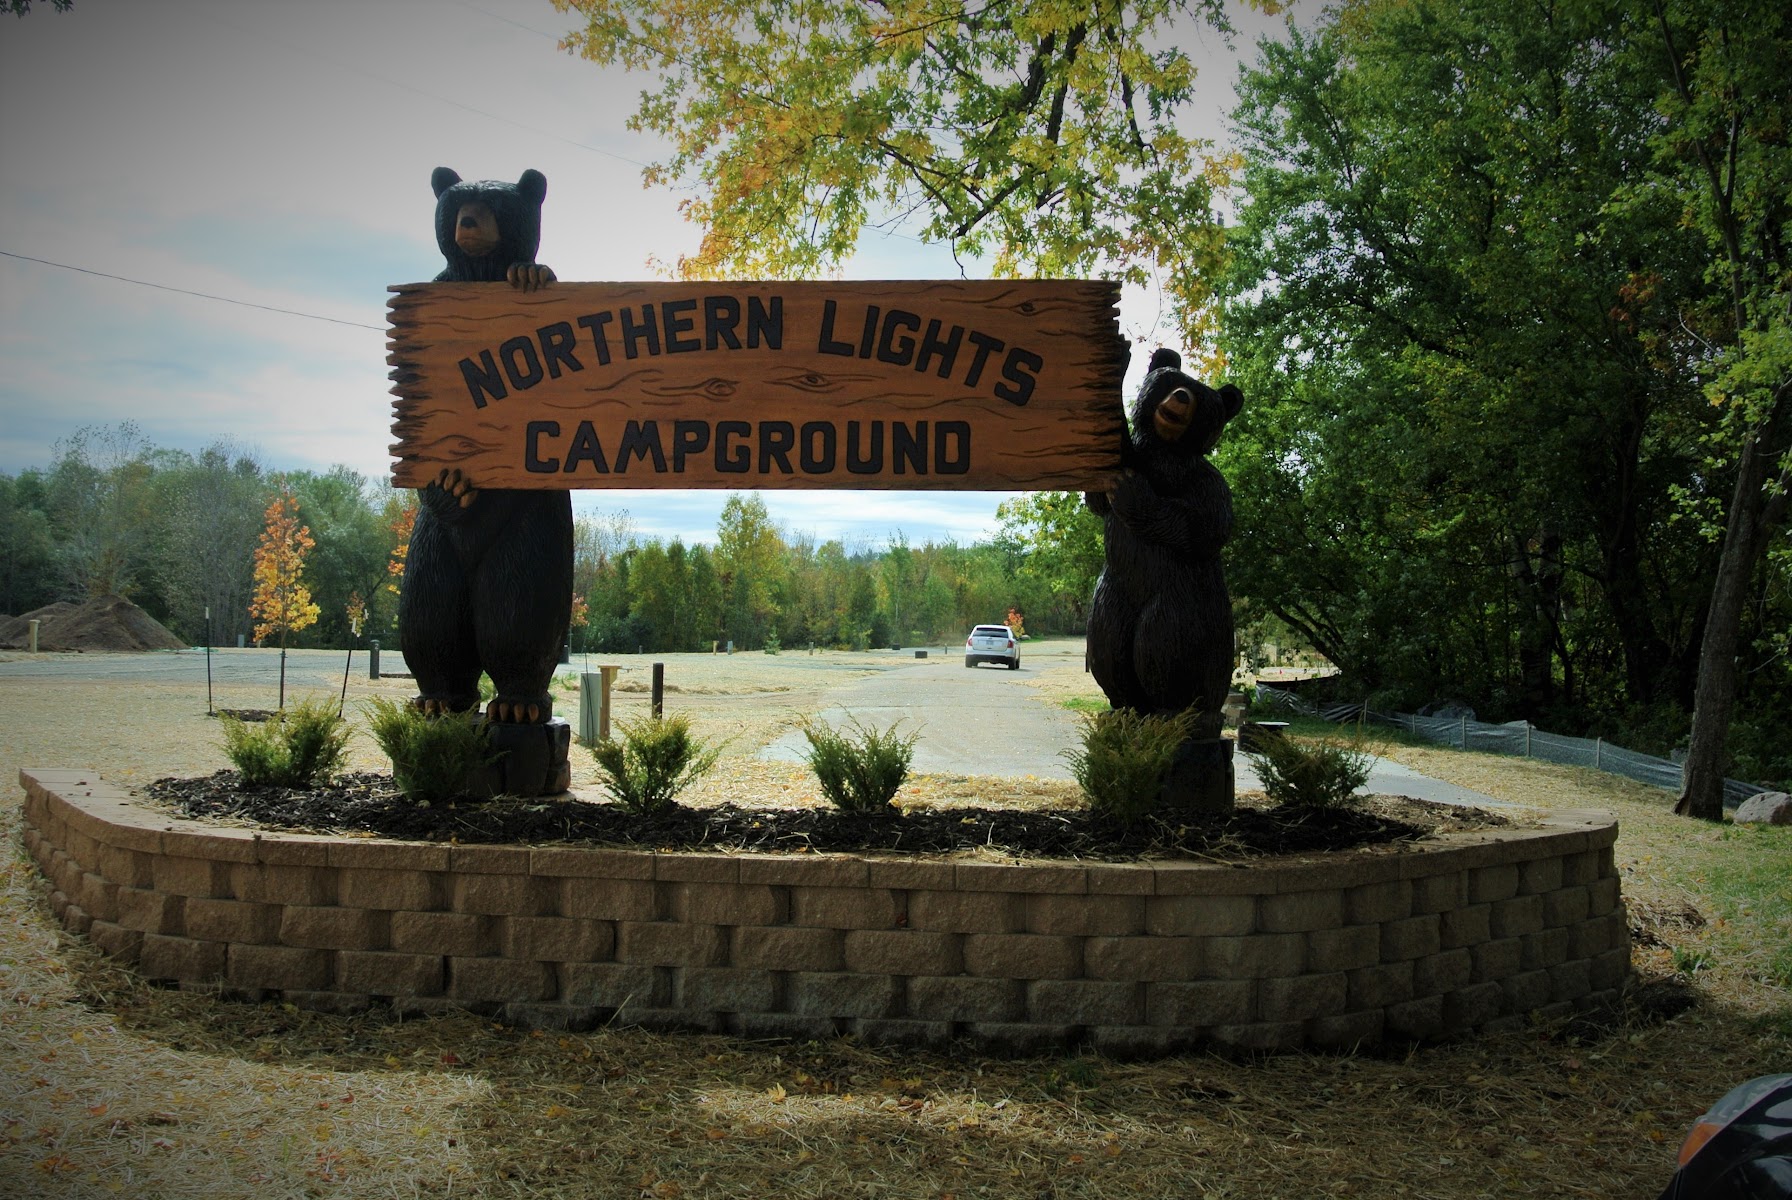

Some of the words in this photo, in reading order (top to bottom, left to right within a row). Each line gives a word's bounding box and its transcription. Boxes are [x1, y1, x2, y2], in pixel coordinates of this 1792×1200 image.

[457, 295, 784, 410] NORTHERN
[817, 299, 1044, 407] LIGHTS
[524, 419, 971, 475] CAMPGROUND
